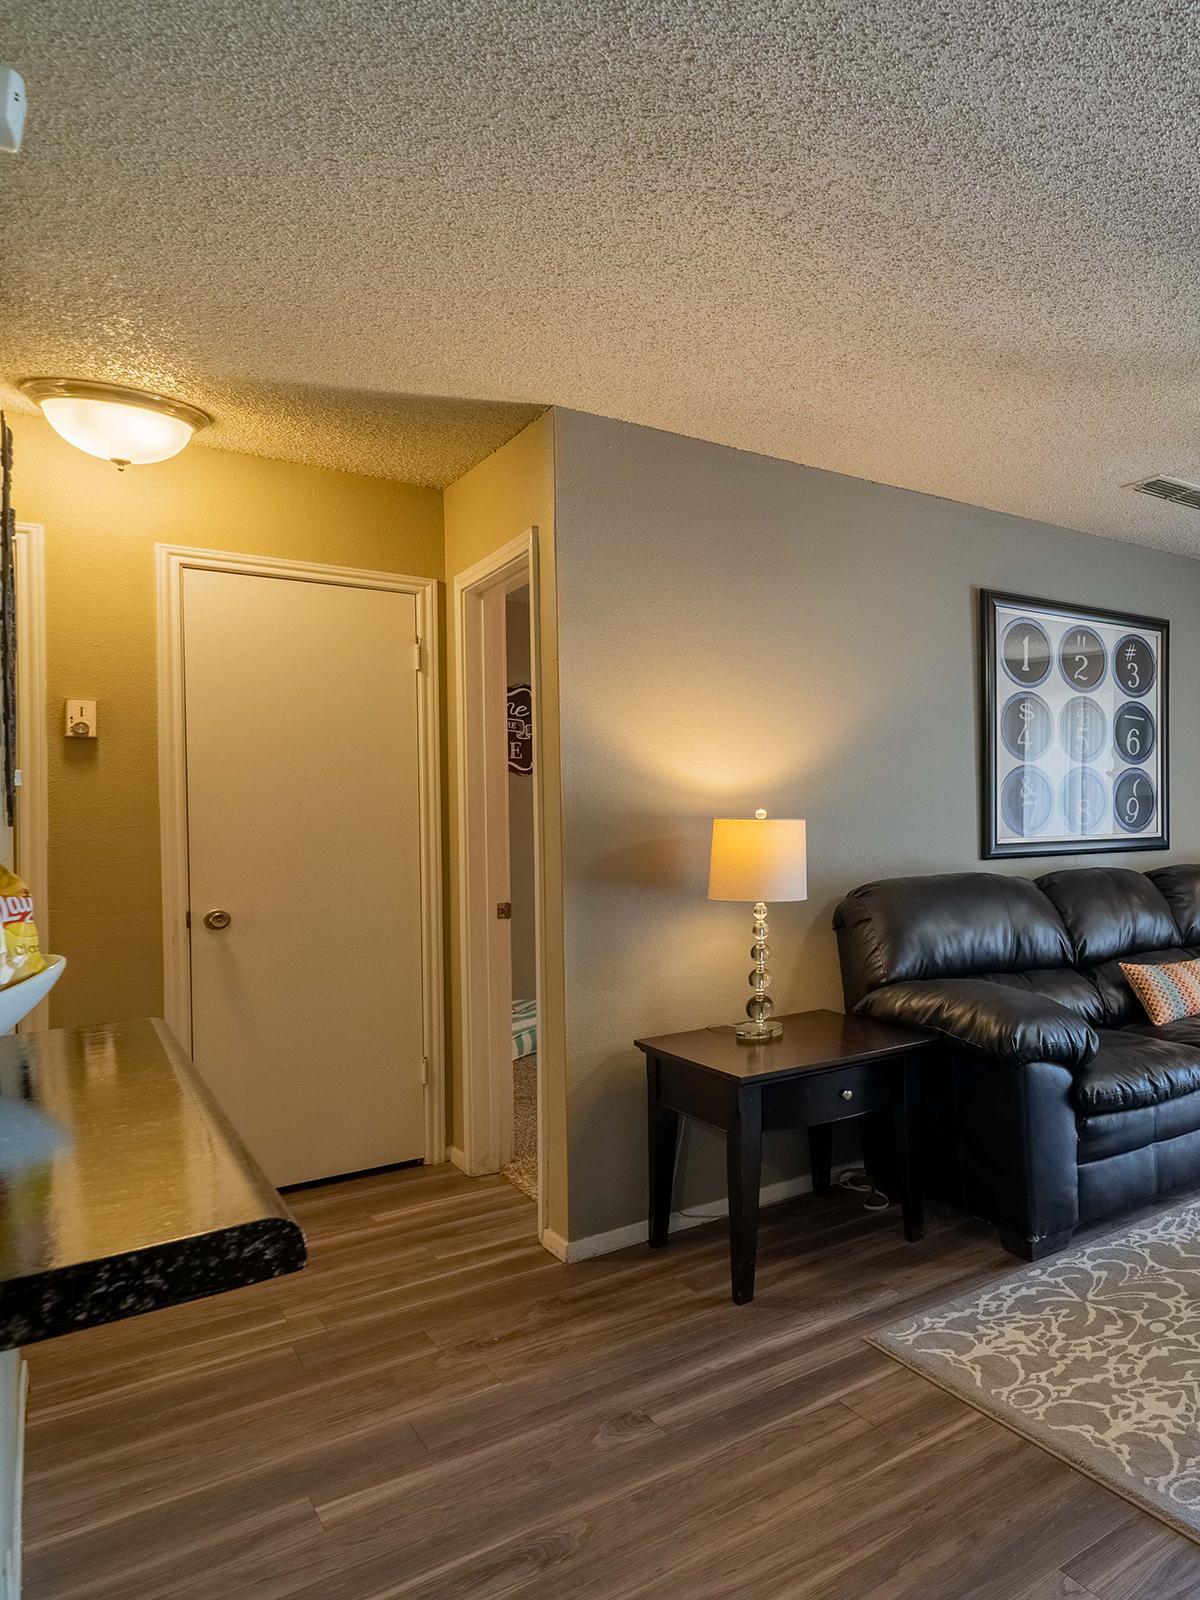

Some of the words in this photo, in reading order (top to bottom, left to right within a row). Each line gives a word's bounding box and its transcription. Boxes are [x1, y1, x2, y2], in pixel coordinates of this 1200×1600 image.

[1021, 635, 1030, 671] 1
[1074, 655, 1089, 681] 2
[1126, 662, 1140, 688] 3
[1126, 727, 1140, 756] 6
[1125, 797, 1140, 823] 9
